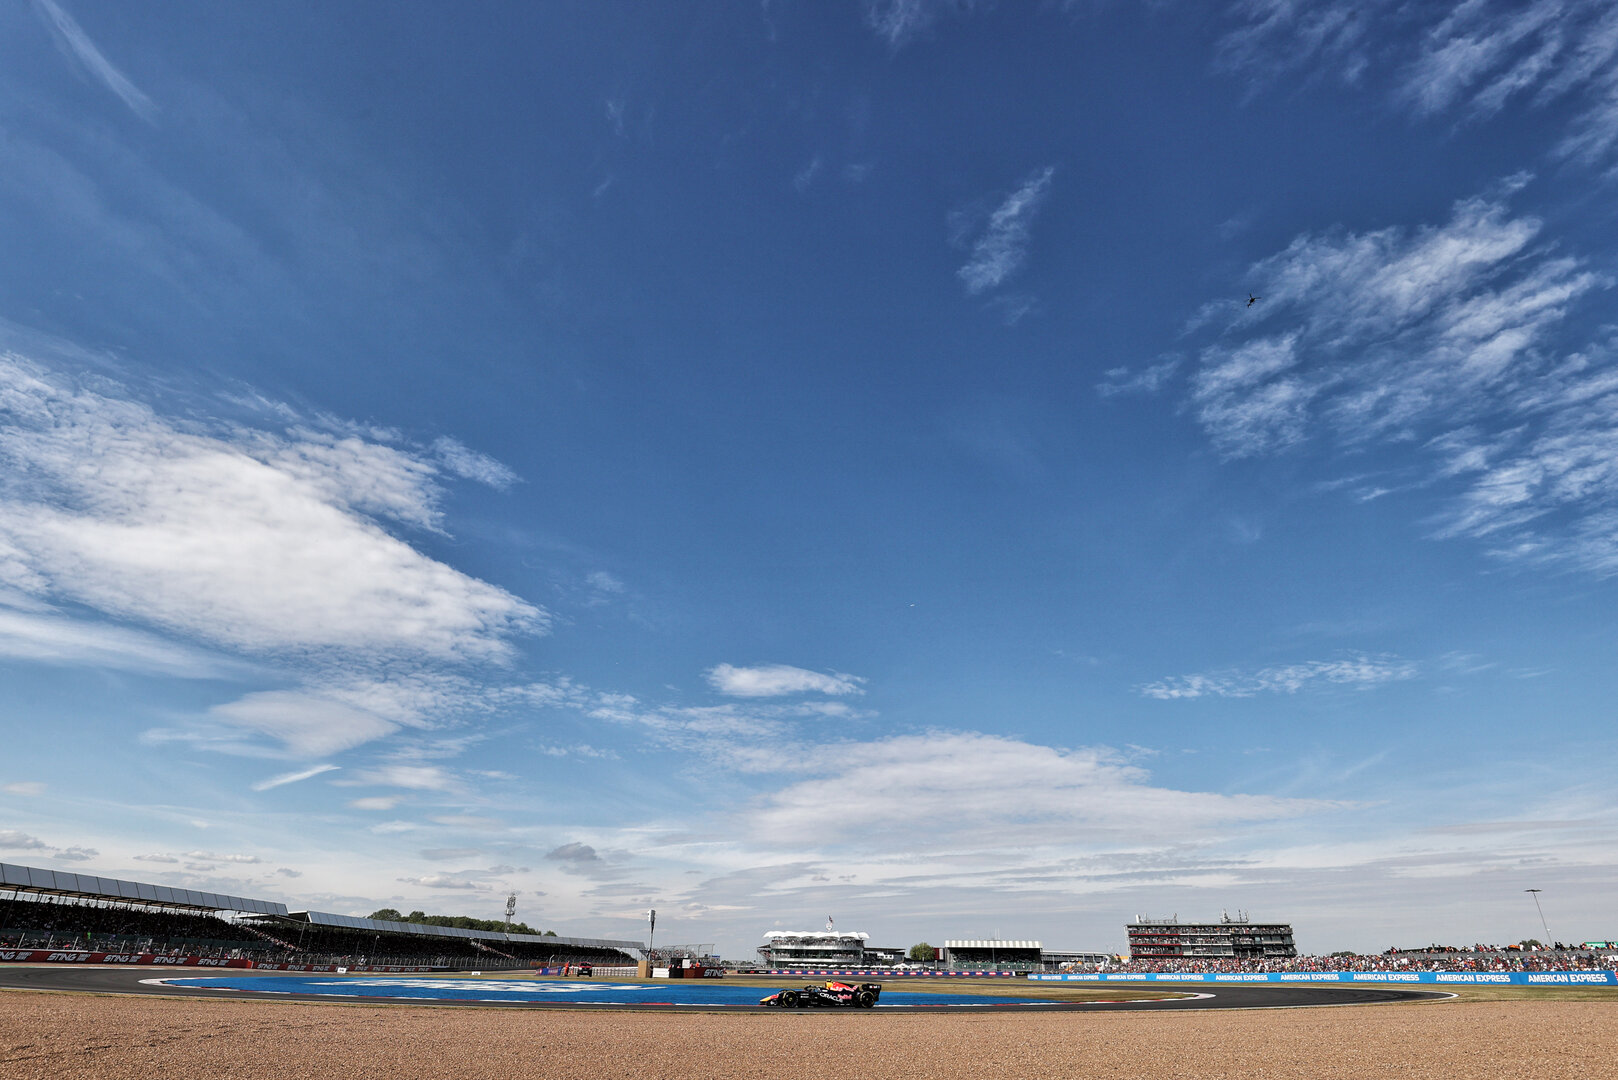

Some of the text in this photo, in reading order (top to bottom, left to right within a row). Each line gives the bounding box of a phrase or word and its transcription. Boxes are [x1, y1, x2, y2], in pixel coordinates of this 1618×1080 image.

[47, 953, 76, 961] STING
[1528, 974, 1607, 982] AMERICAN EXPRESS
